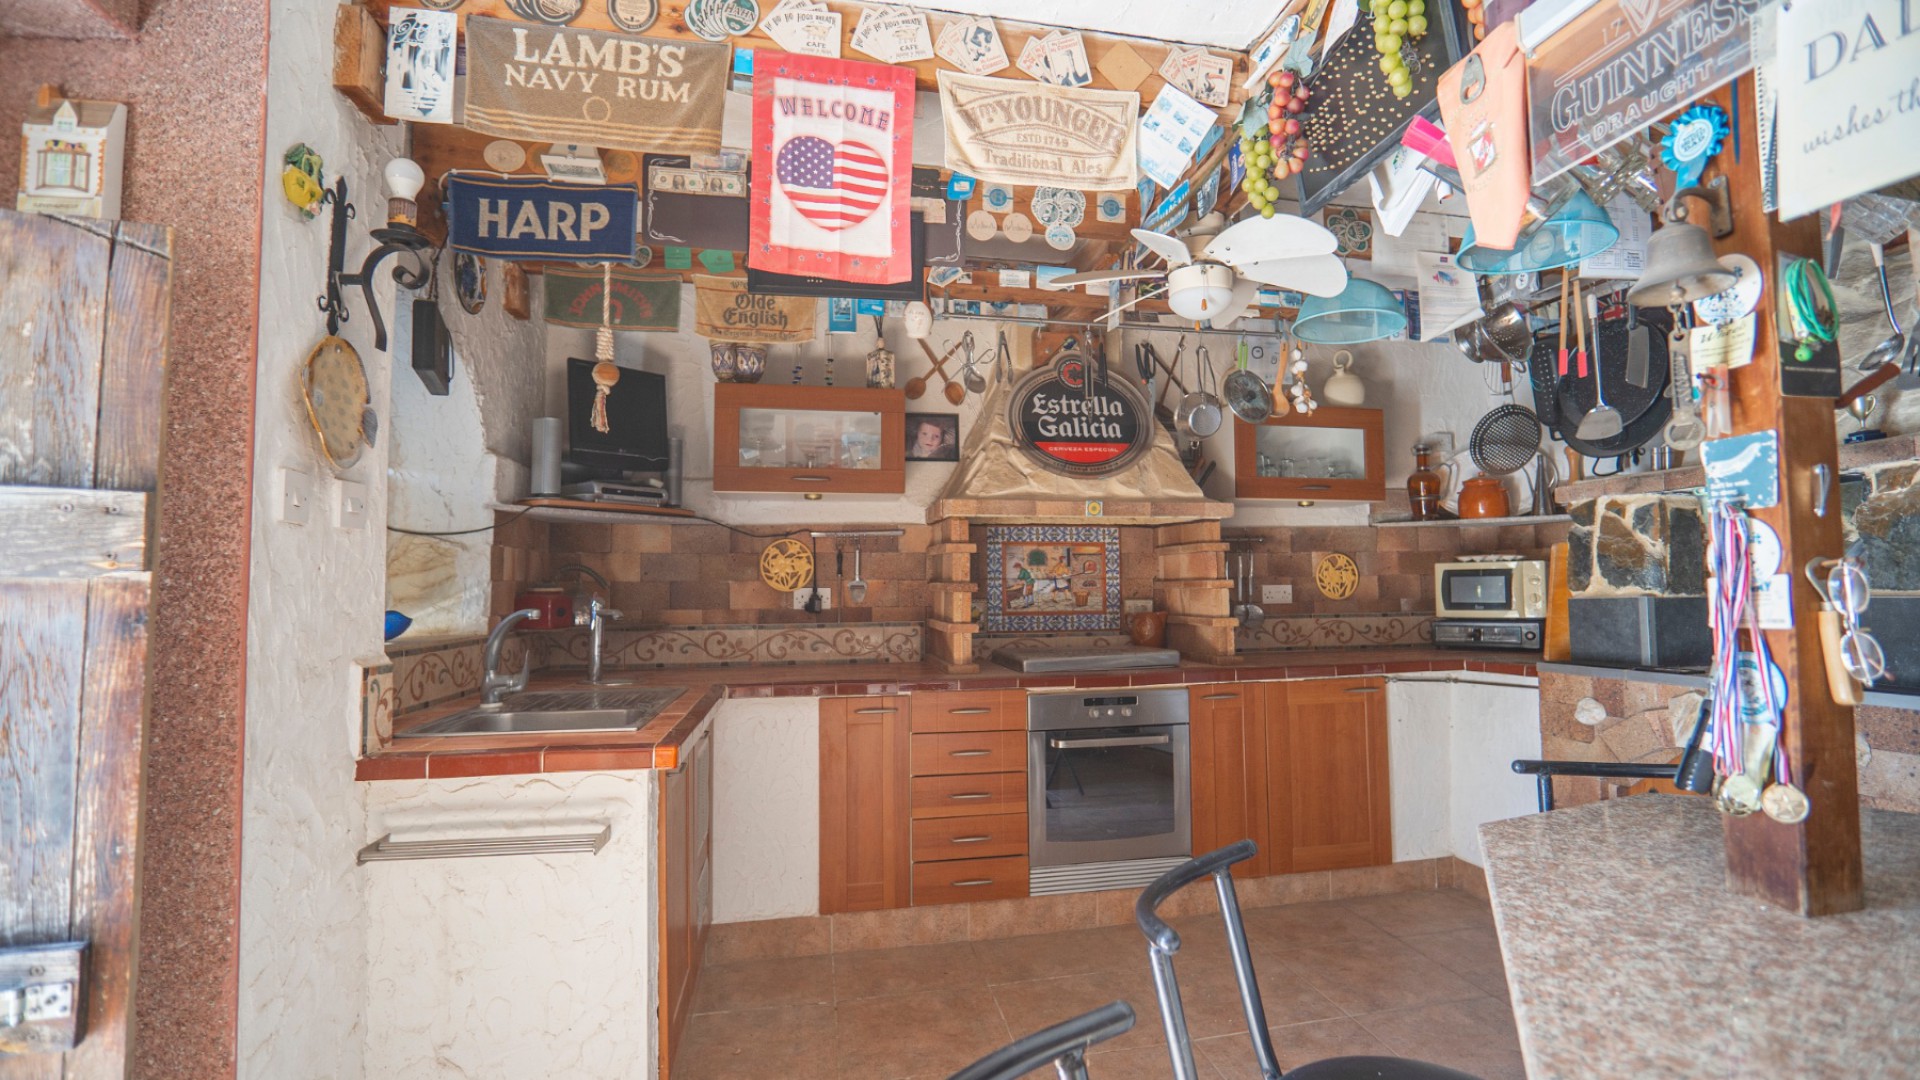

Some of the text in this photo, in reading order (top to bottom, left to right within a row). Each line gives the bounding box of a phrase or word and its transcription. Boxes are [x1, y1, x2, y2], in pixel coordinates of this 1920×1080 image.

[725, 3, 755, 21] HAHN
[512, 27, 686, 78] LAMB'S
[504, 63, 691, 104] NAVY RUM
[777, 94, 890, 133] WELCOME
[1592, 58, 1713, 142] DRAUGHT
[996, 95, 1127, 157] YOUNGER
[1016, 133, 1041, 145] ESTD
[1802, 104, 1890, 155] wishes
[984, 148, 1104, 175] Traditional Ales
[477, 197, 612, 243] HARP
[735, 293, 776, 311] Olde
[722, 307, 789, 329] English
[1031, 392, 1125, 417] Estrella
[1037, 415, 1123, 439] Galicia
[1048, 445, 1083, 453] CERVEZA
